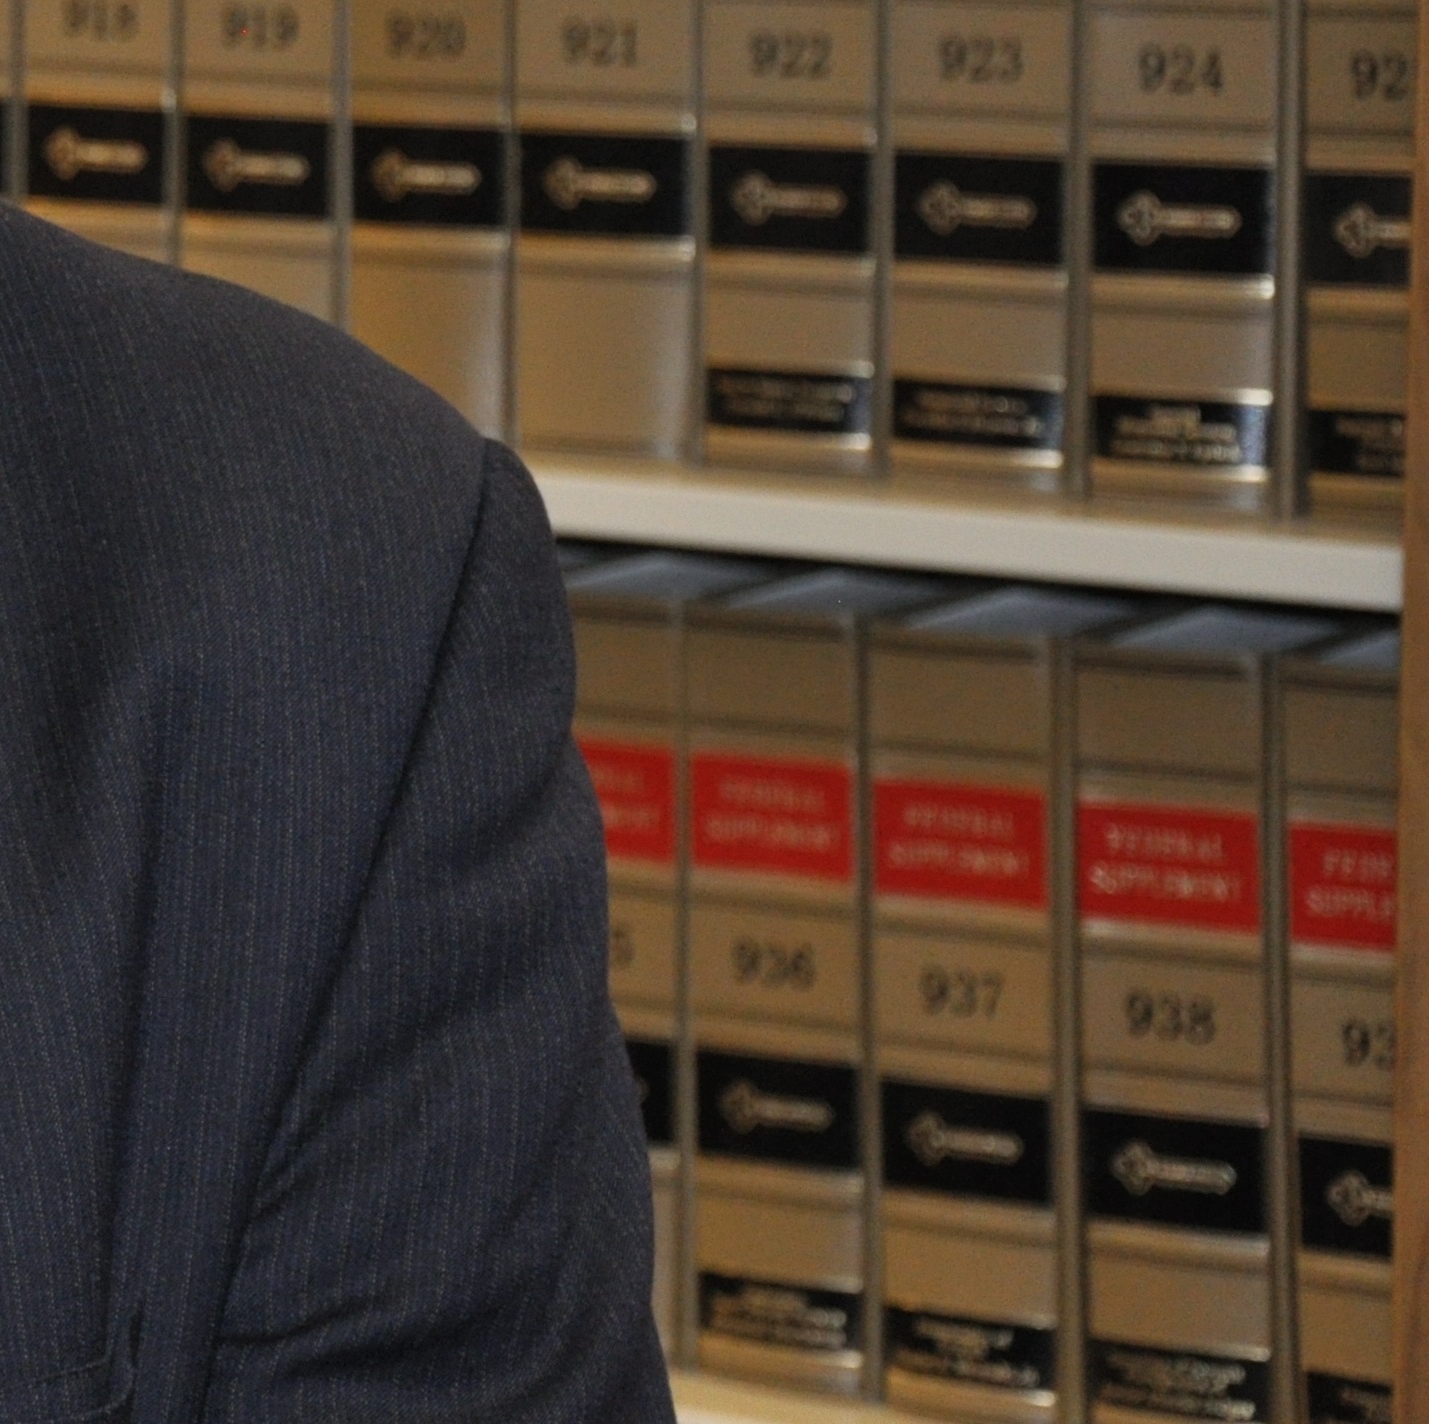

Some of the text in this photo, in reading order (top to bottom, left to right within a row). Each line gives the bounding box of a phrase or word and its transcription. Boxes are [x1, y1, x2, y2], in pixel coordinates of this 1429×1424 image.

[221, 1, 299, 52] 919
[385, 8, 467, 61] 920
[562, 15, 637, 68] 921
[749, 28, 833, 81] 922
[937, 32, 1024, 83] 923
[1138, 41, 1223, 98] 924
[1349, 48, 1409, 102] 92
[1105, 823, 1223, 861] FEDERAL
[1089, 860, 1240, 901] SUPPLEMENT
[730, 935, 816, 991] 936
[918, 962, 1004, 1021] 937
[1125, 986, 1216, 1047] 938
[1342, 1016, 1396, 1072] 93
